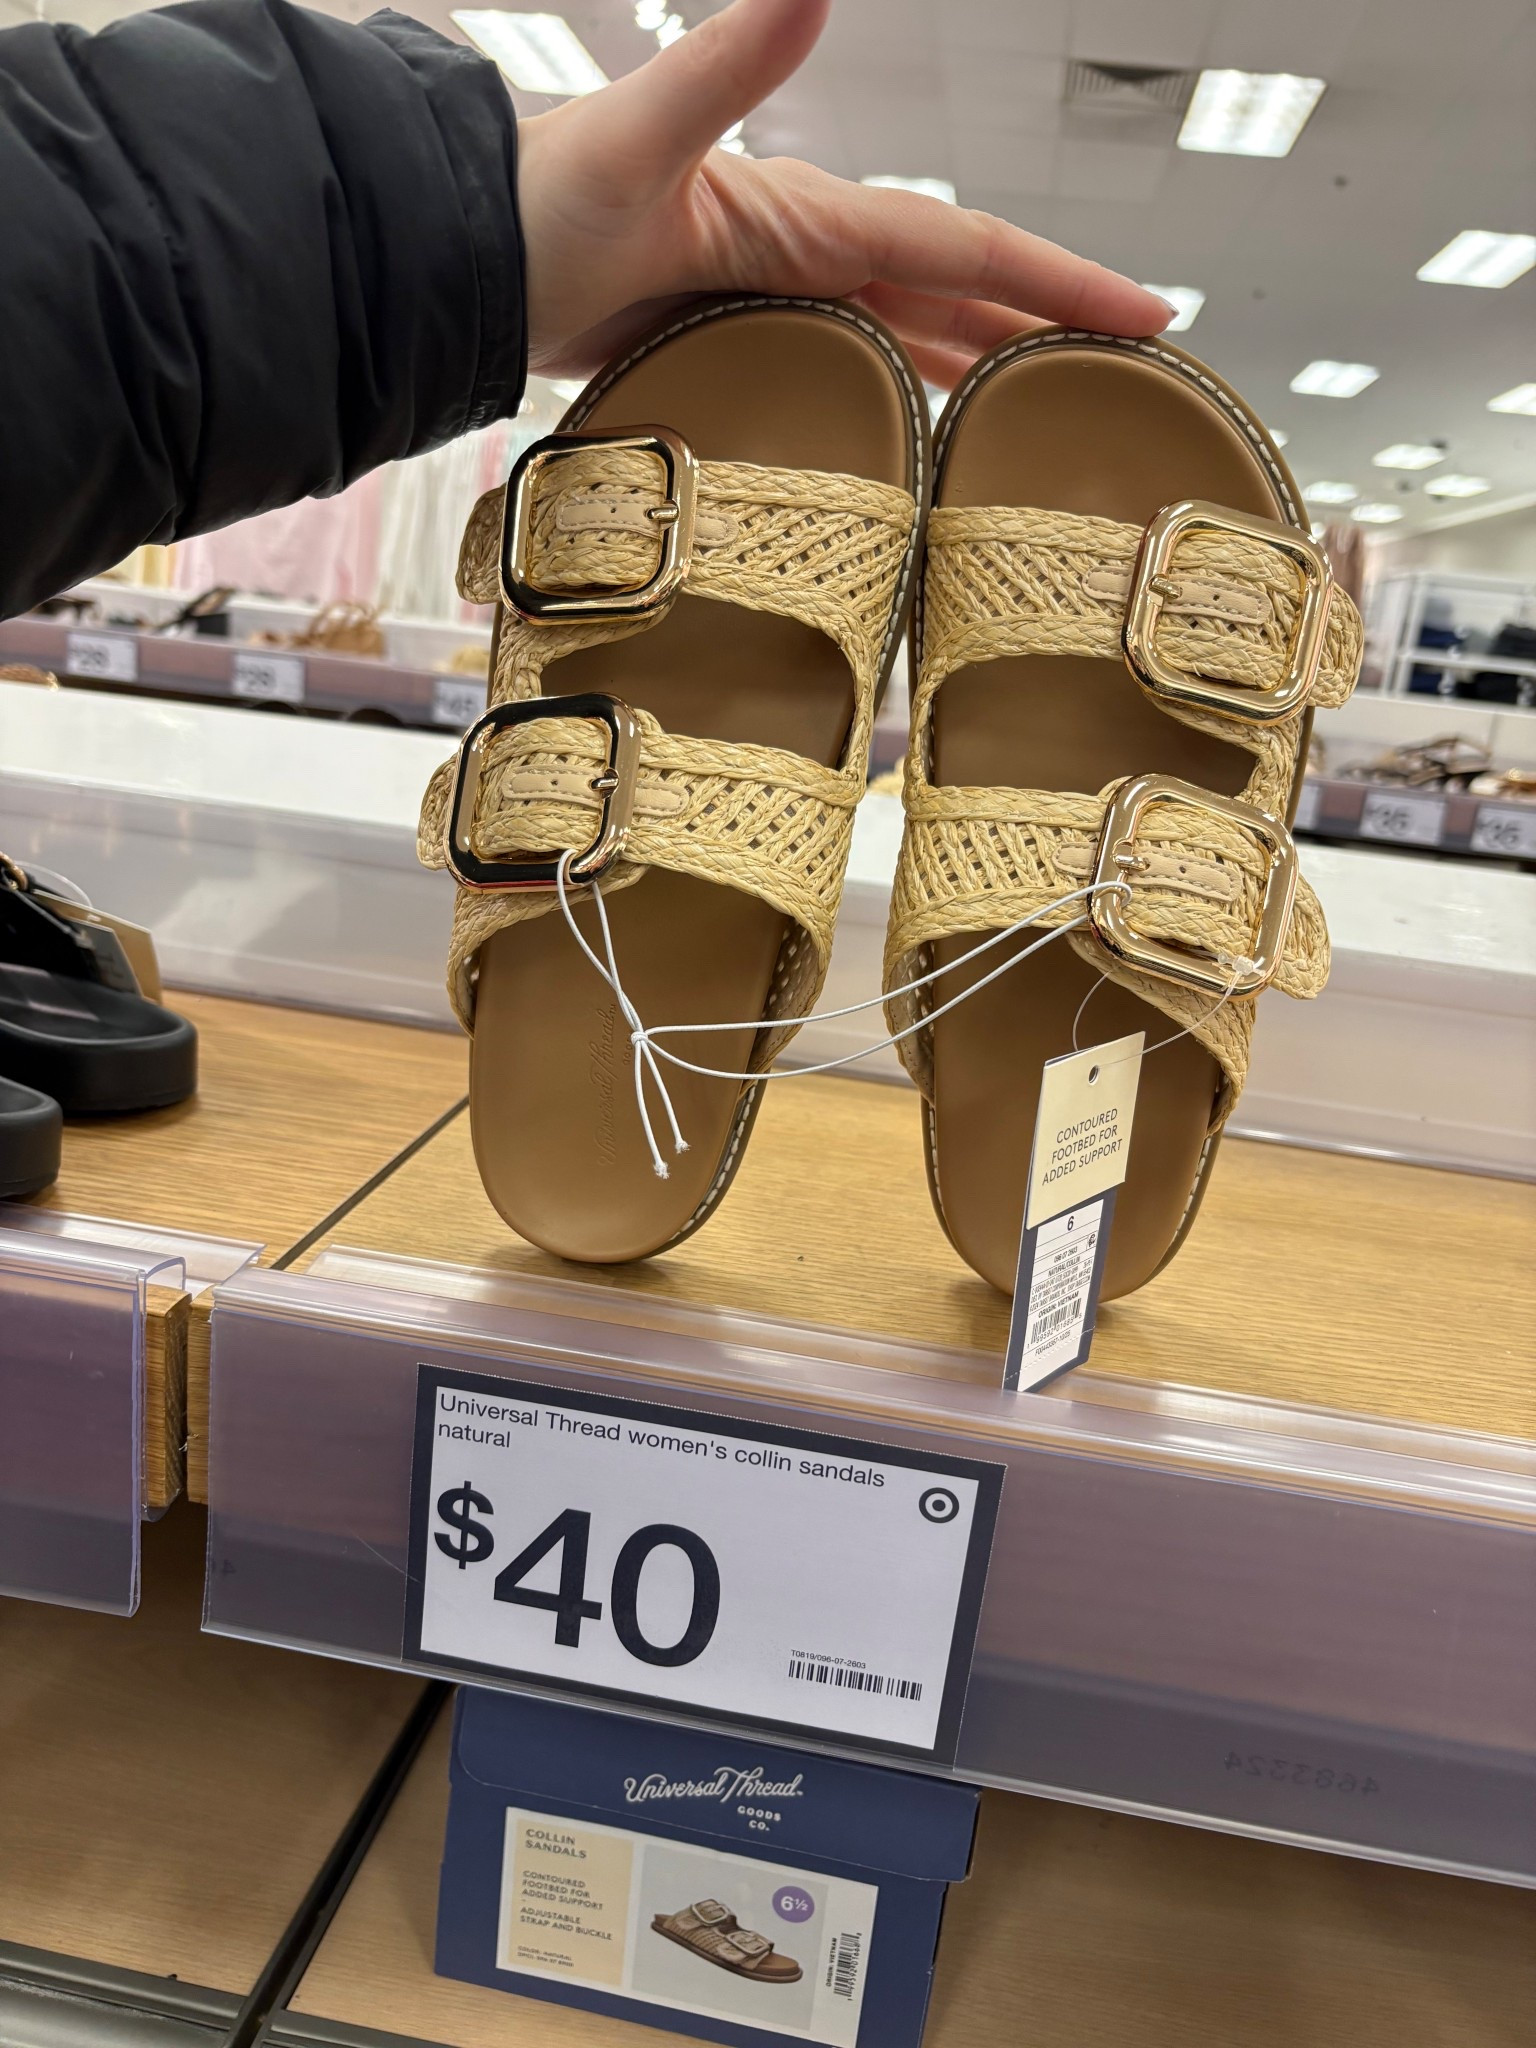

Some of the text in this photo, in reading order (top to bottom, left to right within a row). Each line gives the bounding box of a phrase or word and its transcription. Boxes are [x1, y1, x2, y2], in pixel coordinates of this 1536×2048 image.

[1056, 1108, 1118, 1143] CONTOURED
[1052, 1124, 1118, 1164] FOOTBED FOR
[1042, 1138, 1123, 1186] ADDED SUPPORT
[1067, 1215, 1075, 1231] 6
[438, 1423, 511, 1448] natural
[440, 1393, 885, 1487] Universal Thread women's collin sandals
[434, 1480, 721, 1668] $40
[623, 1770, 729, 1803] Universal
[737, 1805, 782, 1822] GOODS
[748, 1819, 770, 1832] CO.
[525, 1828, 575, 1846] COLLIN
[525, 1840, 587, 1859] SANDALS
[522, 1870, 586, 1888] CONTOURED
[522, 1880, 590, 1899] FOOTBED FOR
[521, 1888, 603, 1910] ADDED SUPPORT
[520, 1906, 581, 1925] ADJUSTABLE
[520, 1915, 613, 1941] STRAP AND BUCKLE
